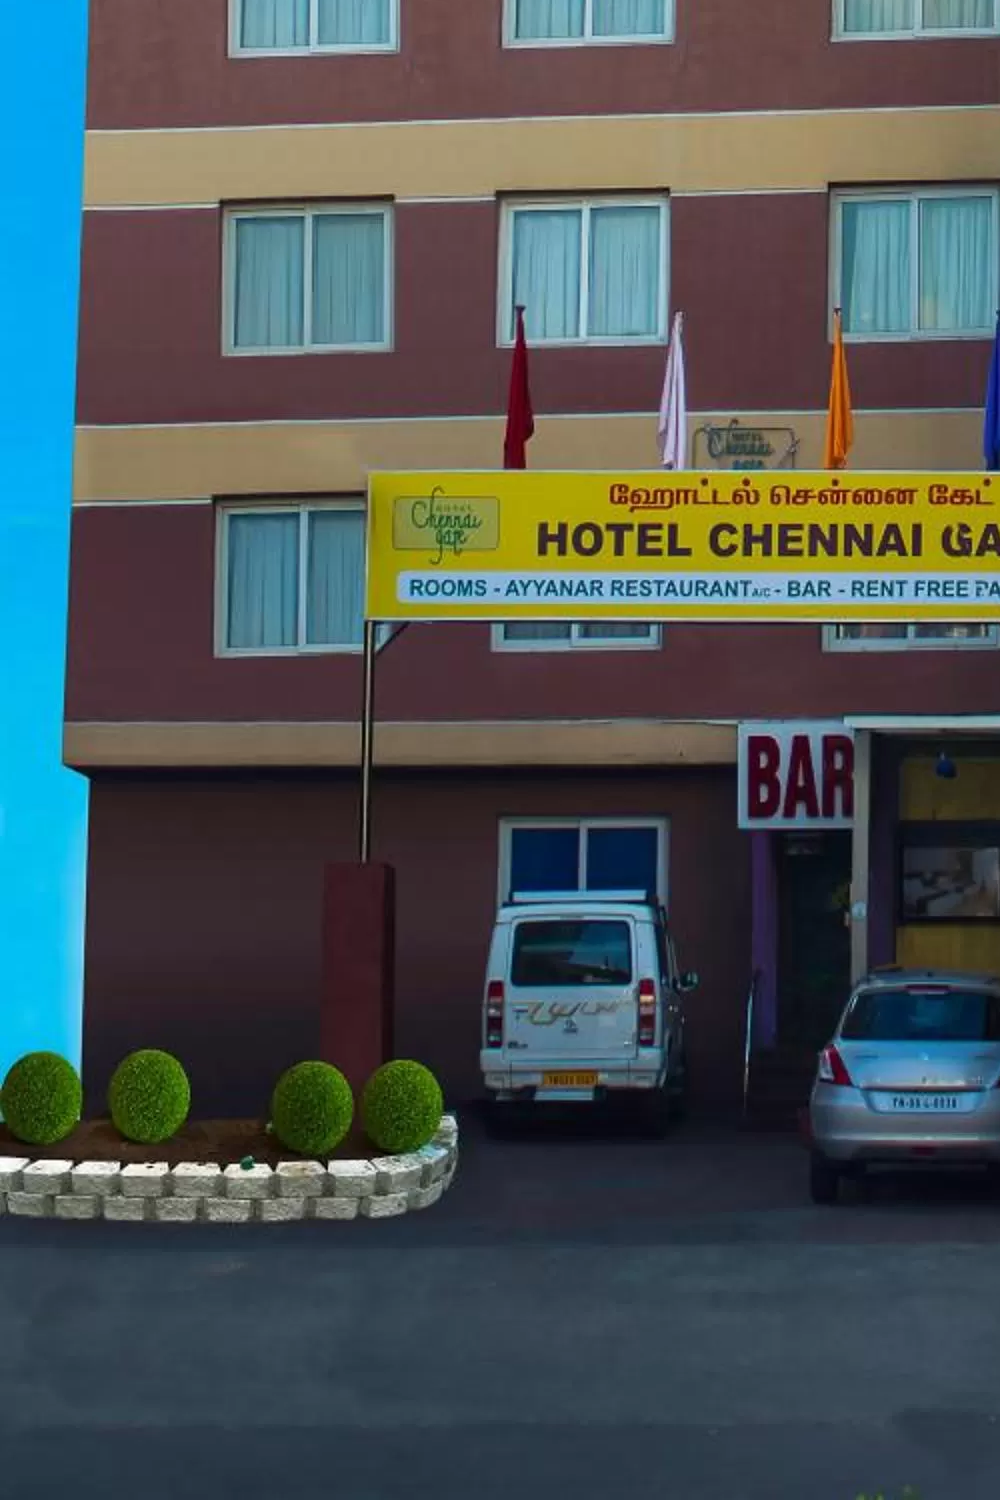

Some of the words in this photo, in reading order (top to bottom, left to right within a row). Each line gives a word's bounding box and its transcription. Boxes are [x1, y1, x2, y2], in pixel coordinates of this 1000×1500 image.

[608, 478, 760, 513] ஹோட்டல்
[769, 478, 918, 506] சென்னை
[927, 478, 994, 506] கேட்
[537, 520, 692, 558] HOTEL
[708, 521, 923, 558] CHENNAI
[408, 579, 488, 598] ROOMS
[505, 579, 604, 598] AYYANAR
[610, 579, 752, 598] RESTAURANT
[787, 580, 832, 598] BAR
[851, 580, 910, 598] RENT
[914, 580, 968, 598] FREE
[747, 735, 854, 819] BAR
